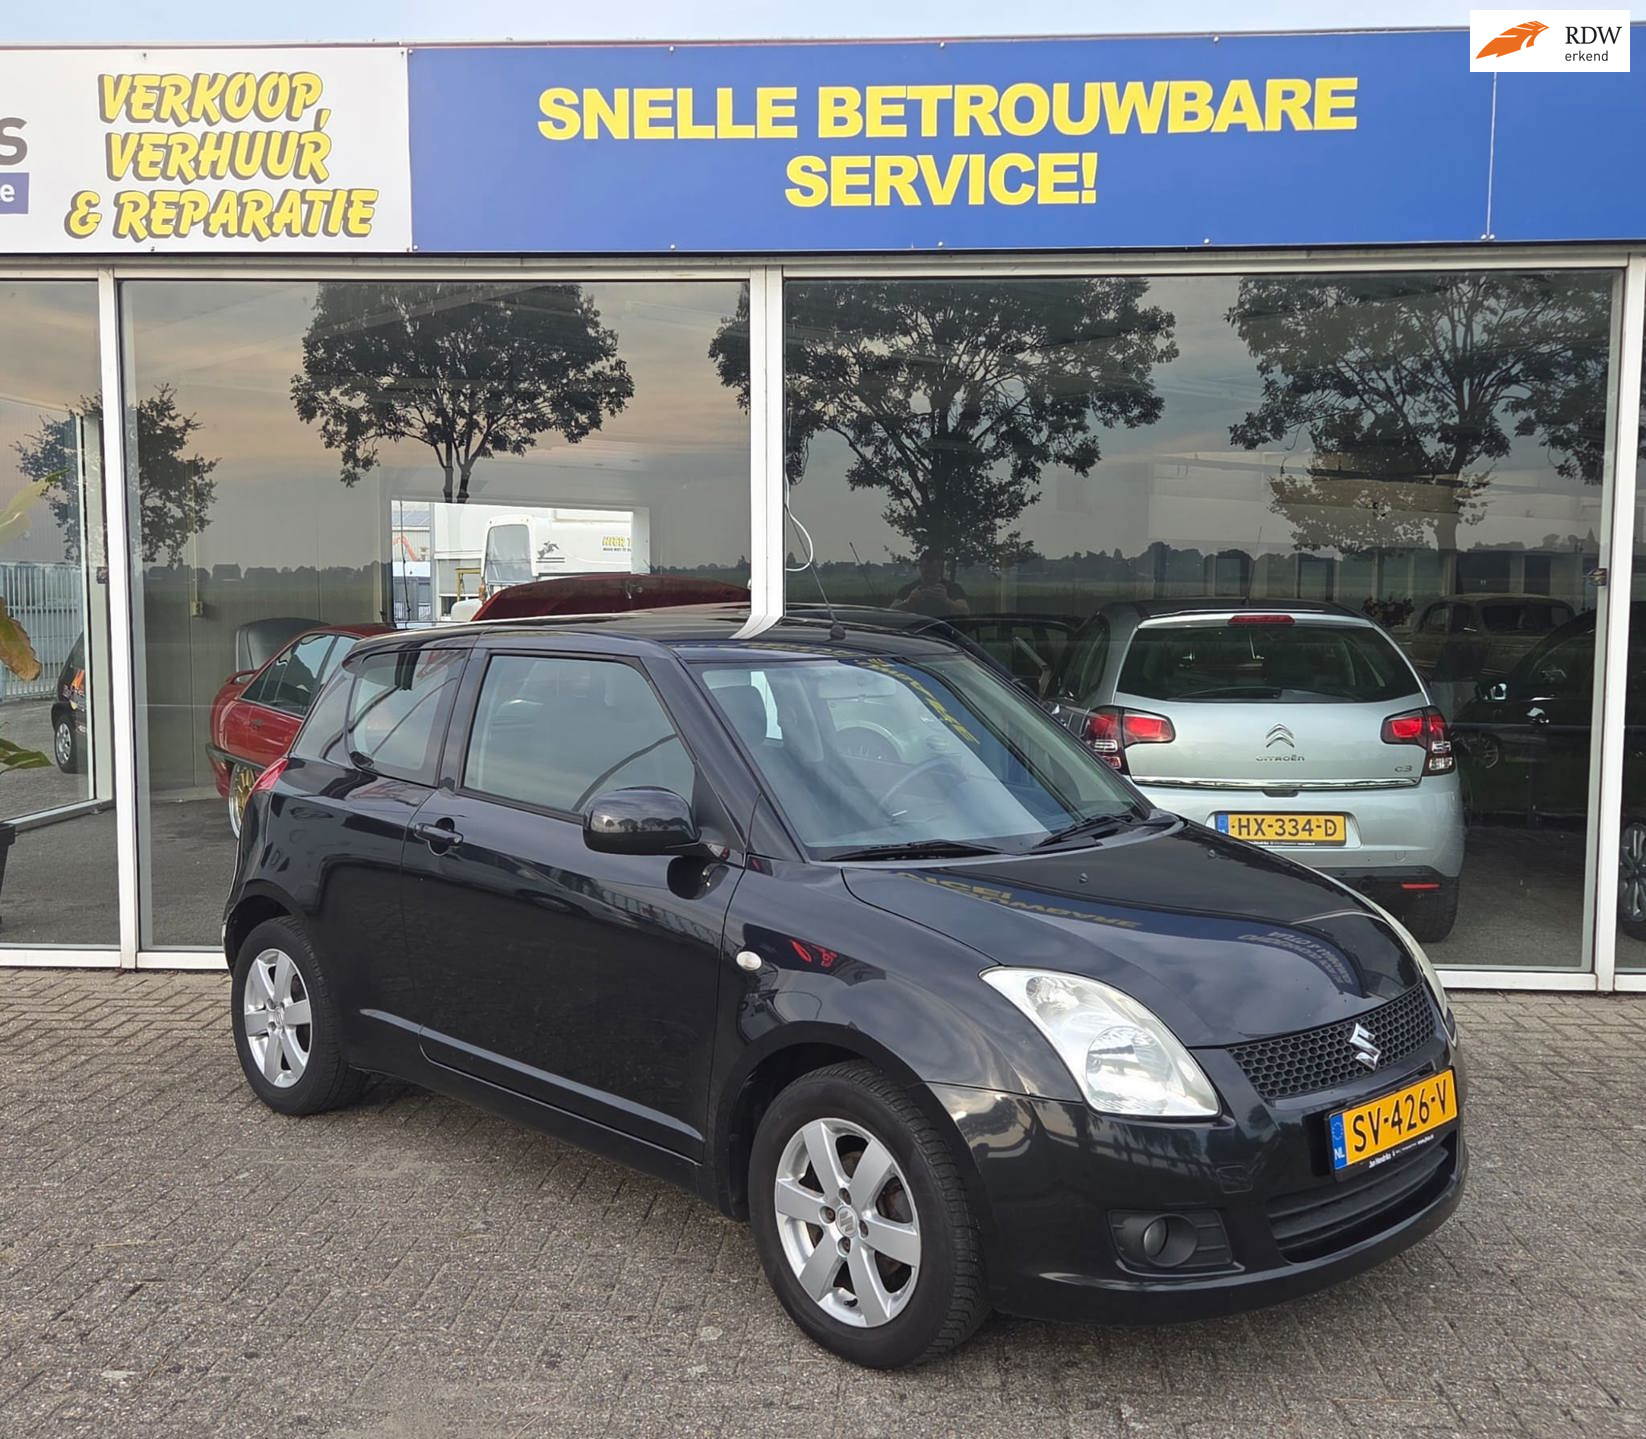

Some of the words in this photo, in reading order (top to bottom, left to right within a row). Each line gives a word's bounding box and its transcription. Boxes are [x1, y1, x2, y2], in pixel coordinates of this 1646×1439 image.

[98, 72, 331, 129] VERKOOP,
[537, 87, 798, 140] SNELLE
[818, 76, 1358, 139] BETROUWBARE
[106, 131, 332, 184] VERHUUR
[784, 152, 1097, 207] SERVICE!
[64, 190, 102, 240] &
[113, 188, 379, 242] REPARATIE
[1237, 818, 1337, 837] HX-334-D
[1352, 1079, 1446, 1153] SV-426-V
[1334, 1146, 1346, 1160] NL
